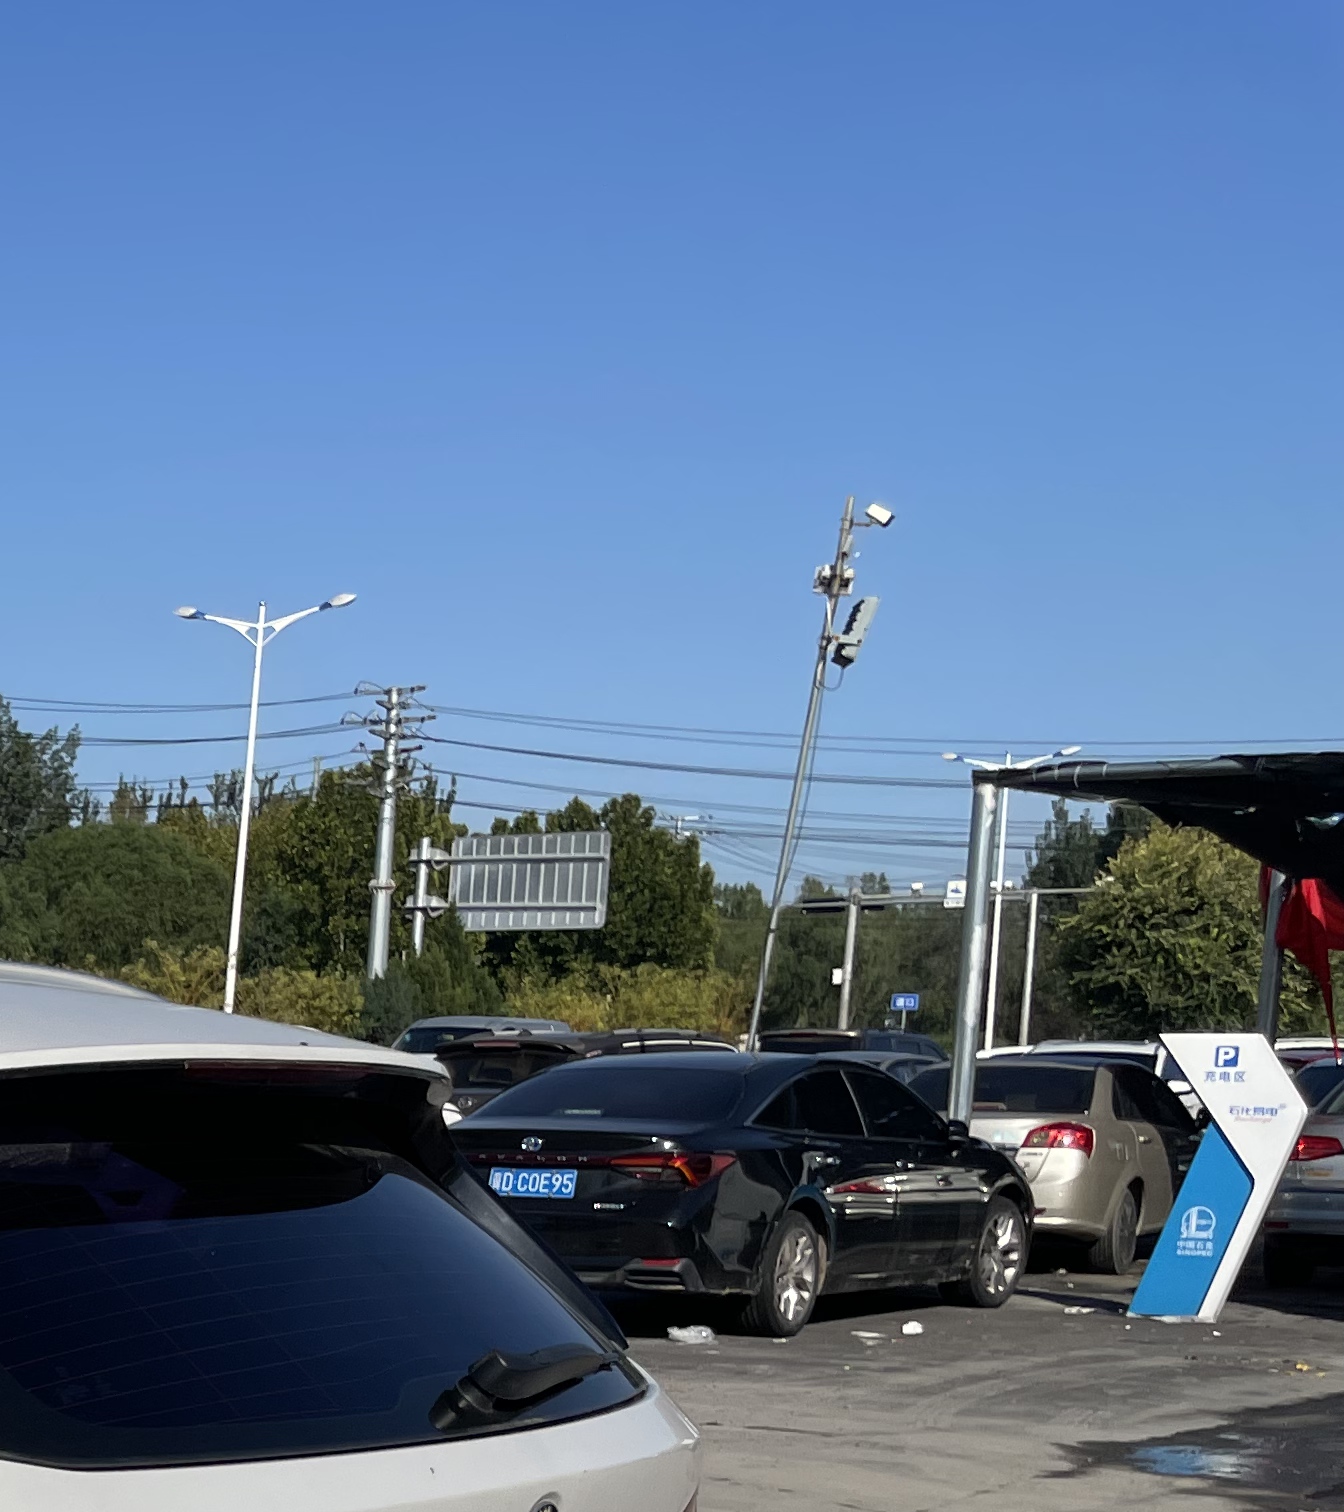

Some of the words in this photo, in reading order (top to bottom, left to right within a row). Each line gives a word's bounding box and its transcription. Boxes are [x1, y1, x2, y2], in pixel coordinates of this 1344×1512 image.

[1217, 1047, 1236, 1067] P
[1204, 1070, 1246, 1083] 充电区
